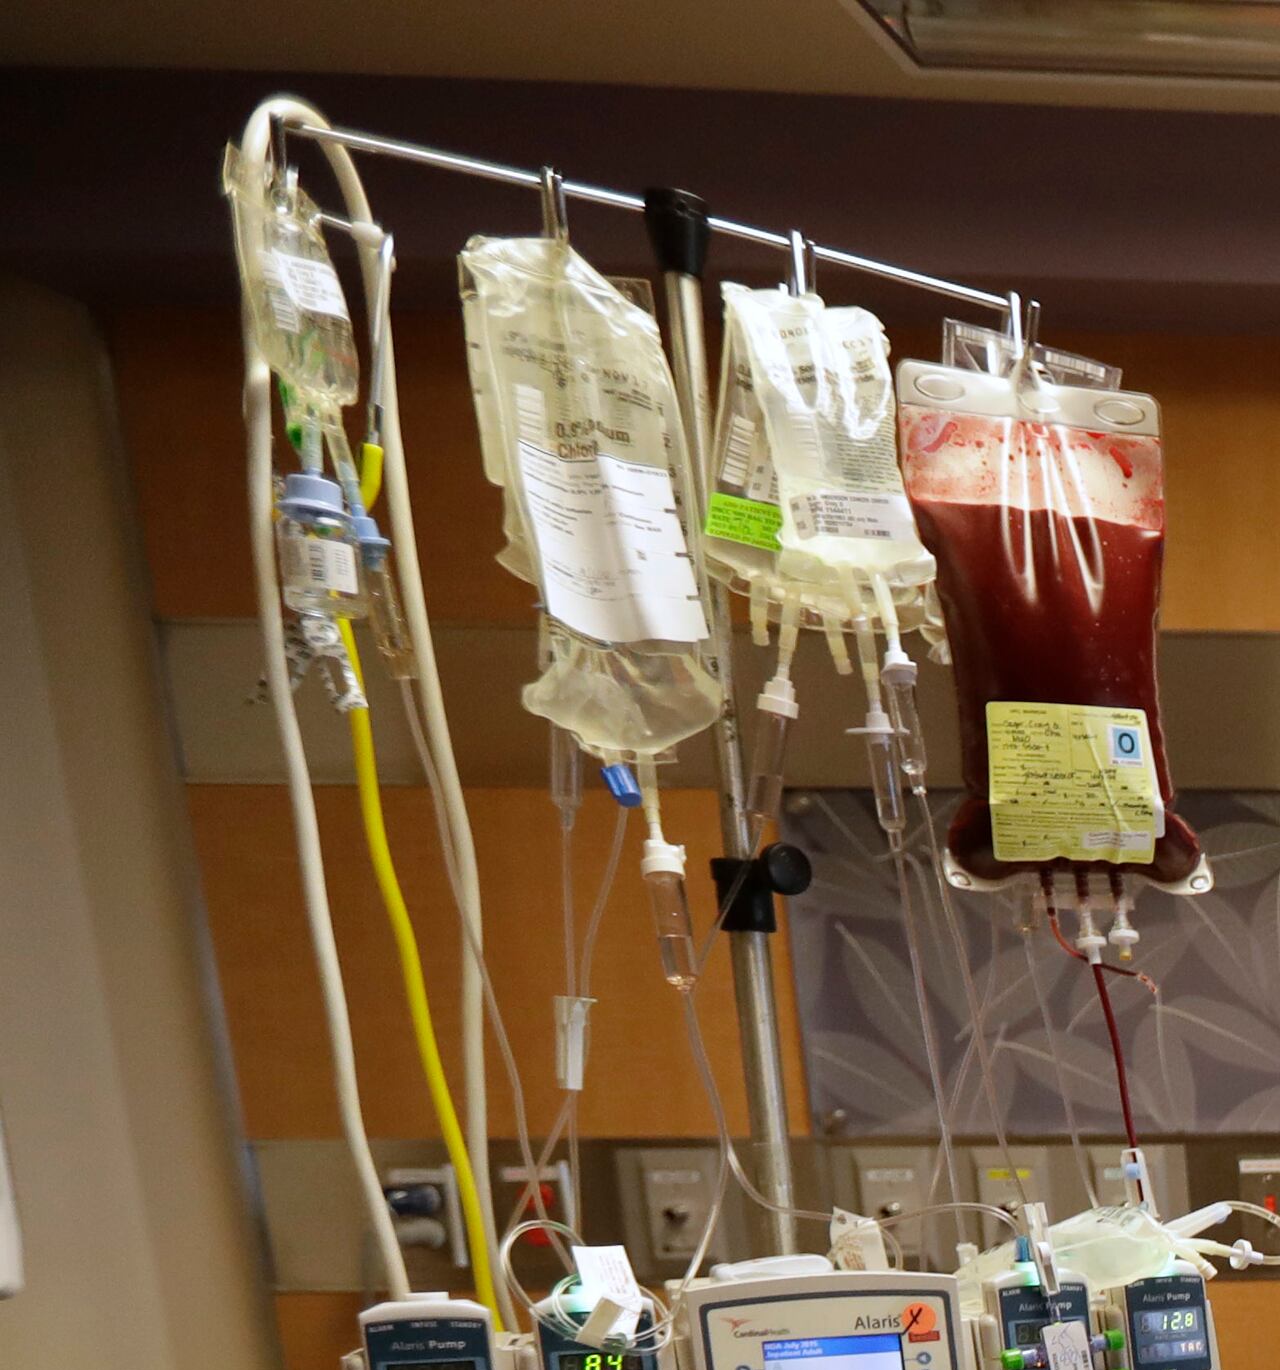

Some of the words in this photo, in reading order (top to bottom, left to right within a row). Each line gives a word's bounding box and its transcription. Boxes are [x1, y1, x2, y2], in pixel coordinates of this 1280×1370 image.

[1118, 733, 1135, 754] O
[1166, 1292, 1191, 1301] Pump
[854, 1315, 901, 1331] Alaris
[1162, 1311, 1194, 1331] 12.8
[428, 1339, 467, 1352] Pump
